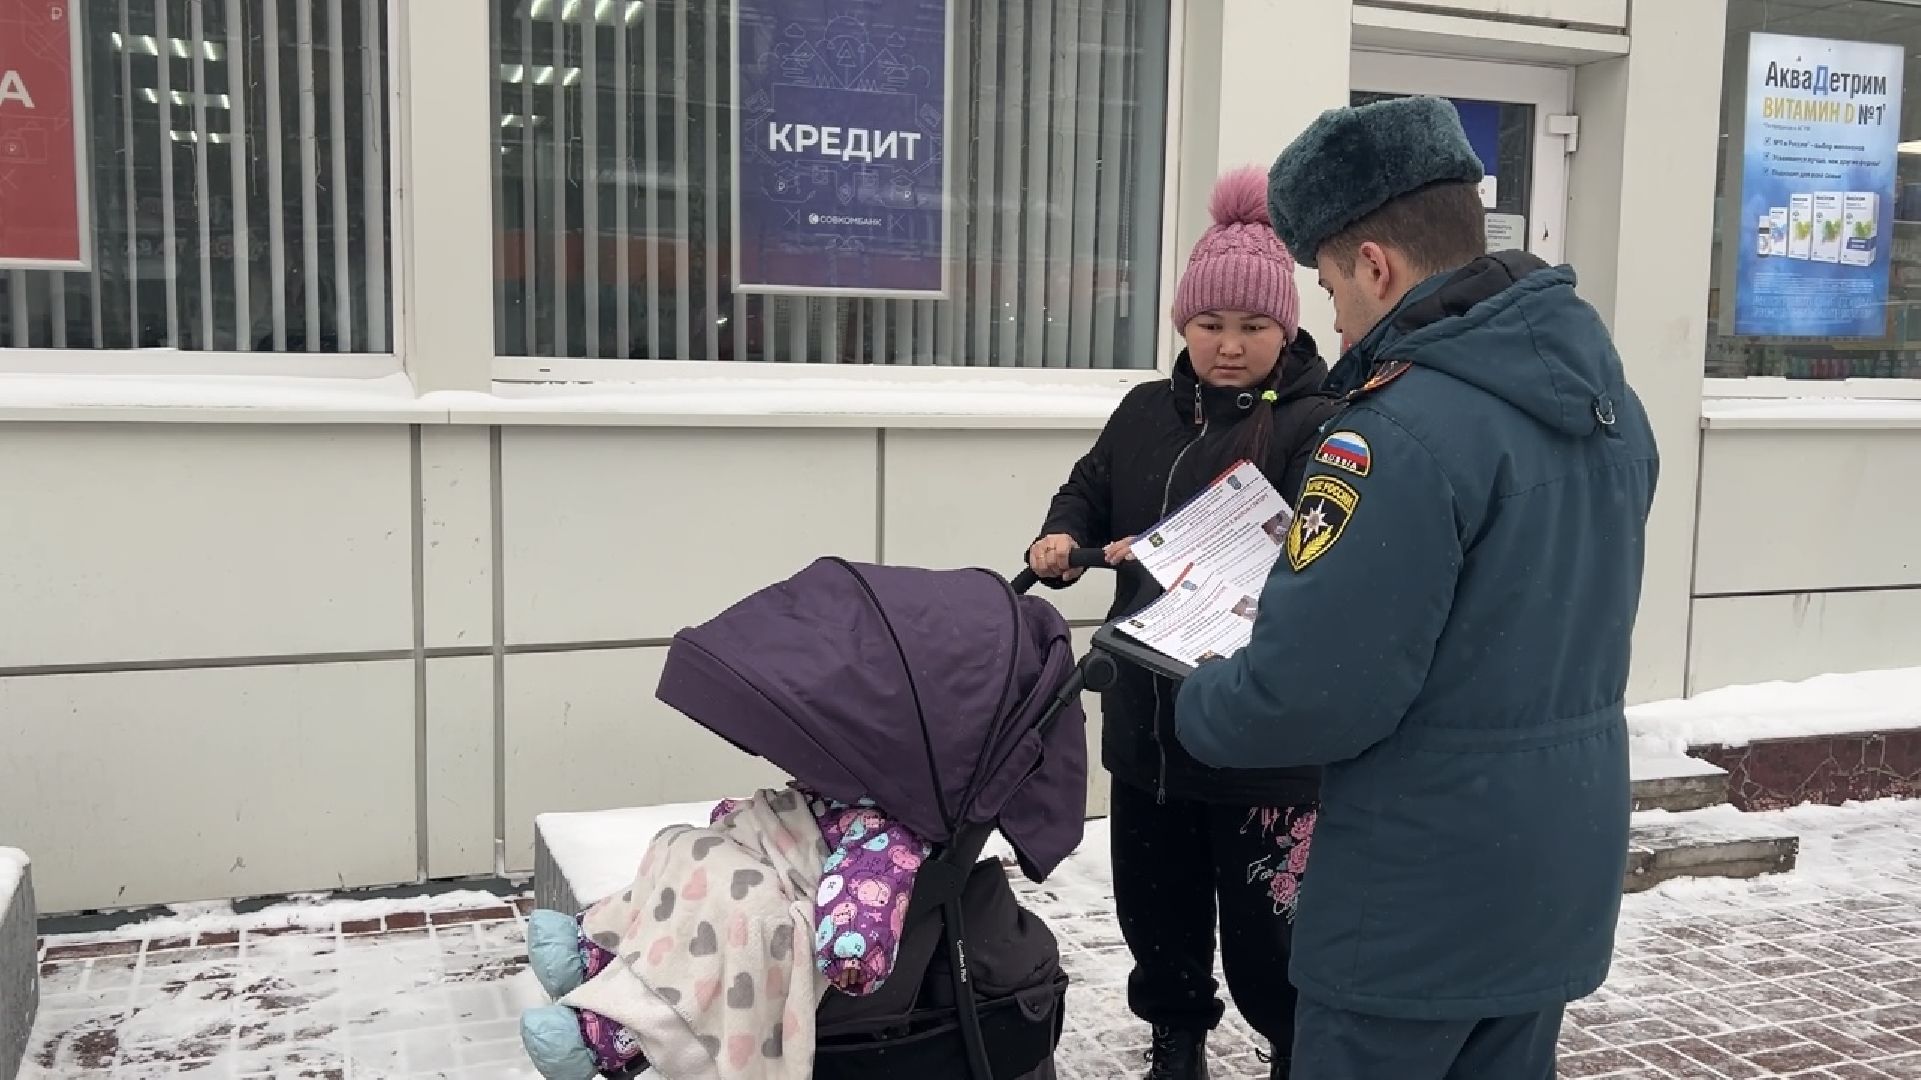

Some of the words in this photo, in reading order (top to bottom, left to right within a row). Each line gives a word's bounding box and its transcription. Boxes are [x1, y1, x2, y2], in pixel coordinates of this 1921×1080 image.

[1765, 61, 1887, 98] АкваДетрим
[1763, 96, 1841, 123] ВИТАМИН
[1844, 103, 1856, 124] D
[769, 122, 921, 163] КРЕДИТ
[820, 214, 882, 226] СОВКОМБАНК
